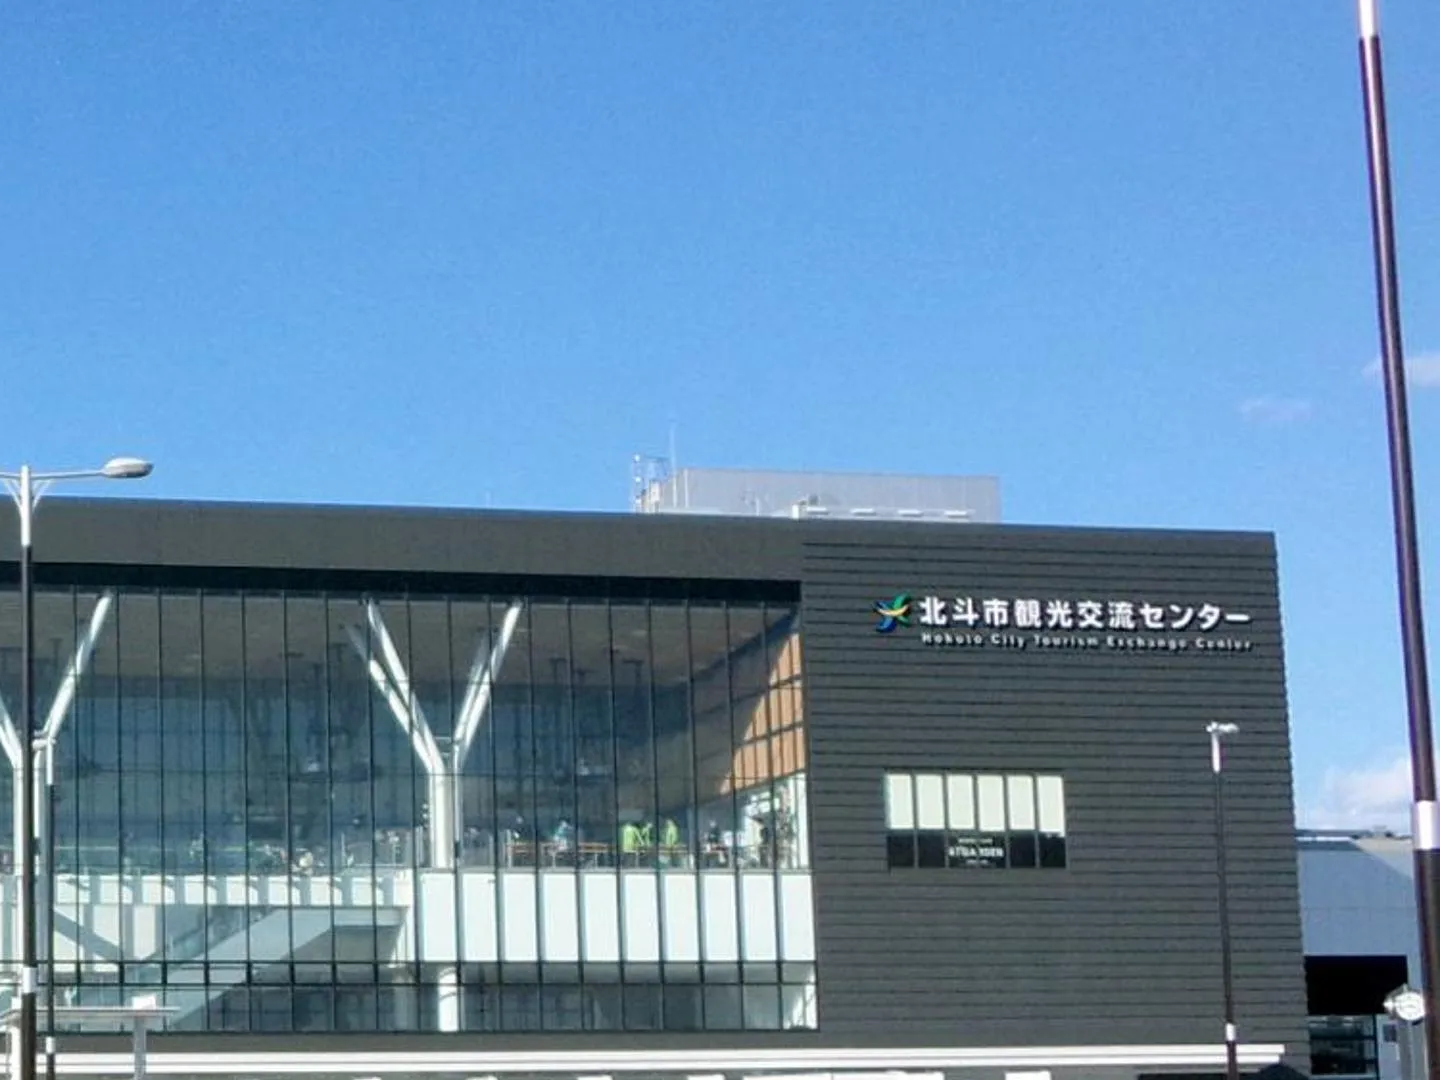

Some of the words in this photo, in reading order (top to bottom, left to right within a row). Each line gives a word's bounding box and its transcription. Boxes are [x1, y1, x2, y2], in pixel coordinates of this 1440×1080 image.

[919, 596, 1251, 630] 北斗市観光交流センター
[990, 632, 1026, 648] City
